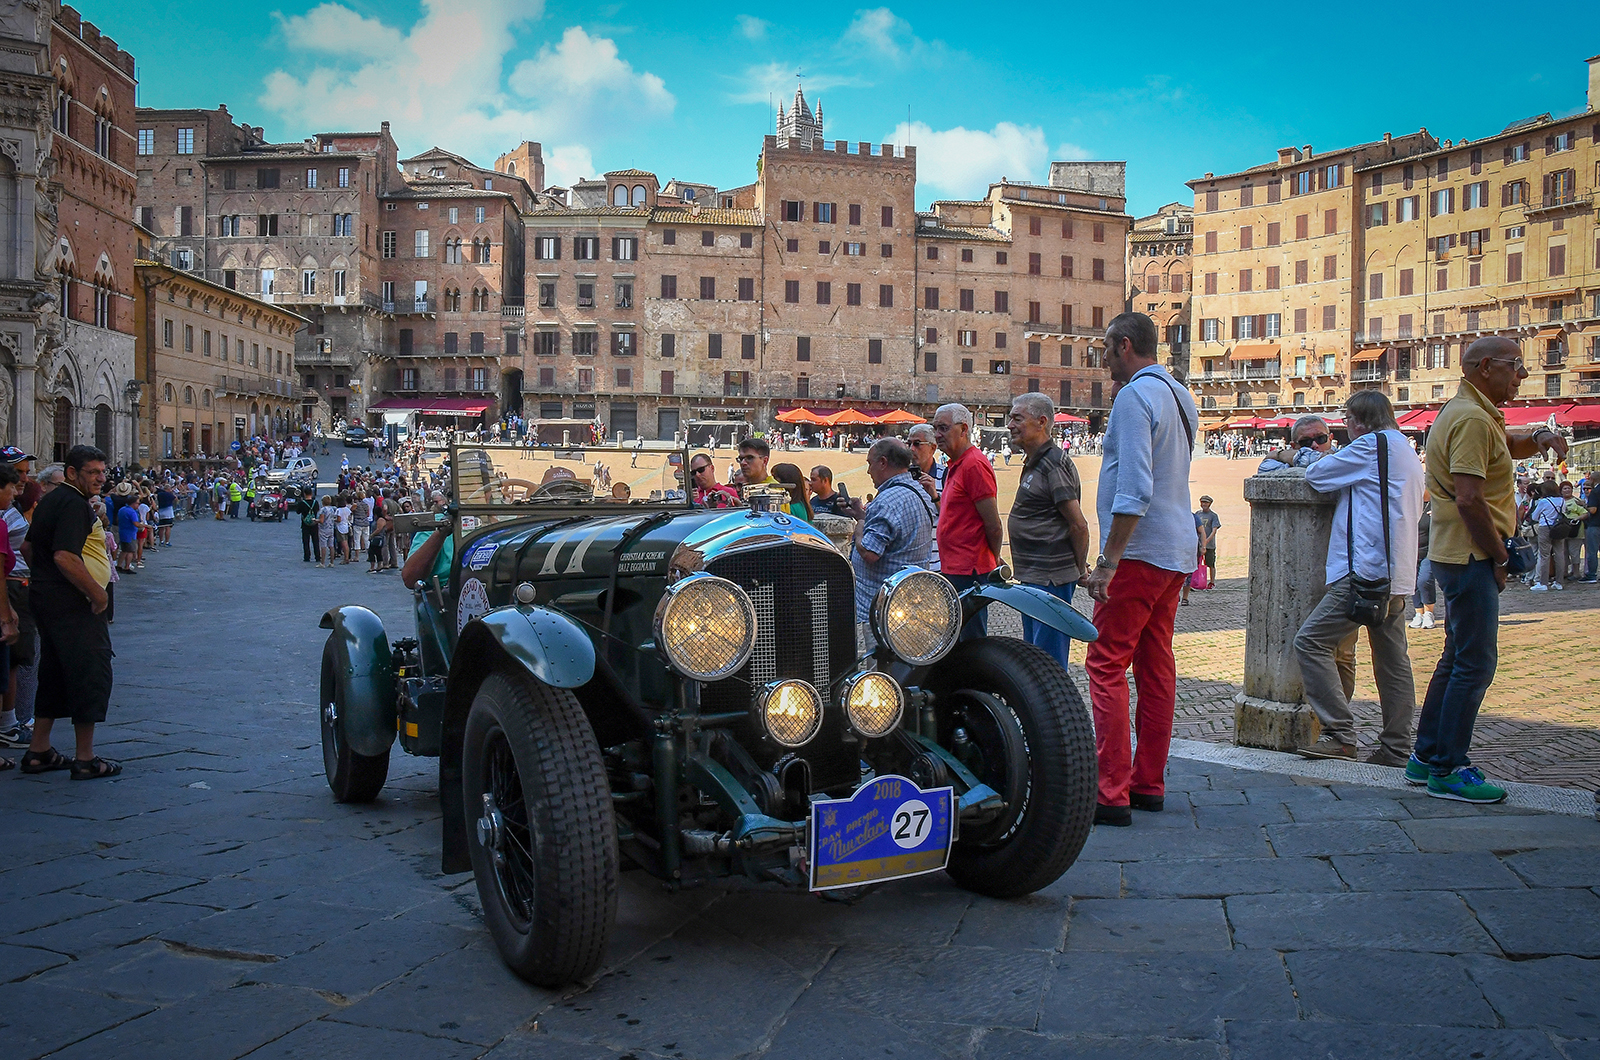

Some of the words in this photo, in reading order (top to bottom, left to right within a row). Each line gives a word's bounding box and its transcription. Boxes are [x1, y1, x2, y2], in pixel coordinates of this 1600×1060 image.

[620, 552, 645, 561] CHRISTIAN
[645, 551, 666, 560] SCHENK
[874, 781, 901, 800] 2018
[846, 808, 879, 834] PREMIO
[894, 809, 930, 840] 27
[829, 816, 889, 861] Nuvolari
